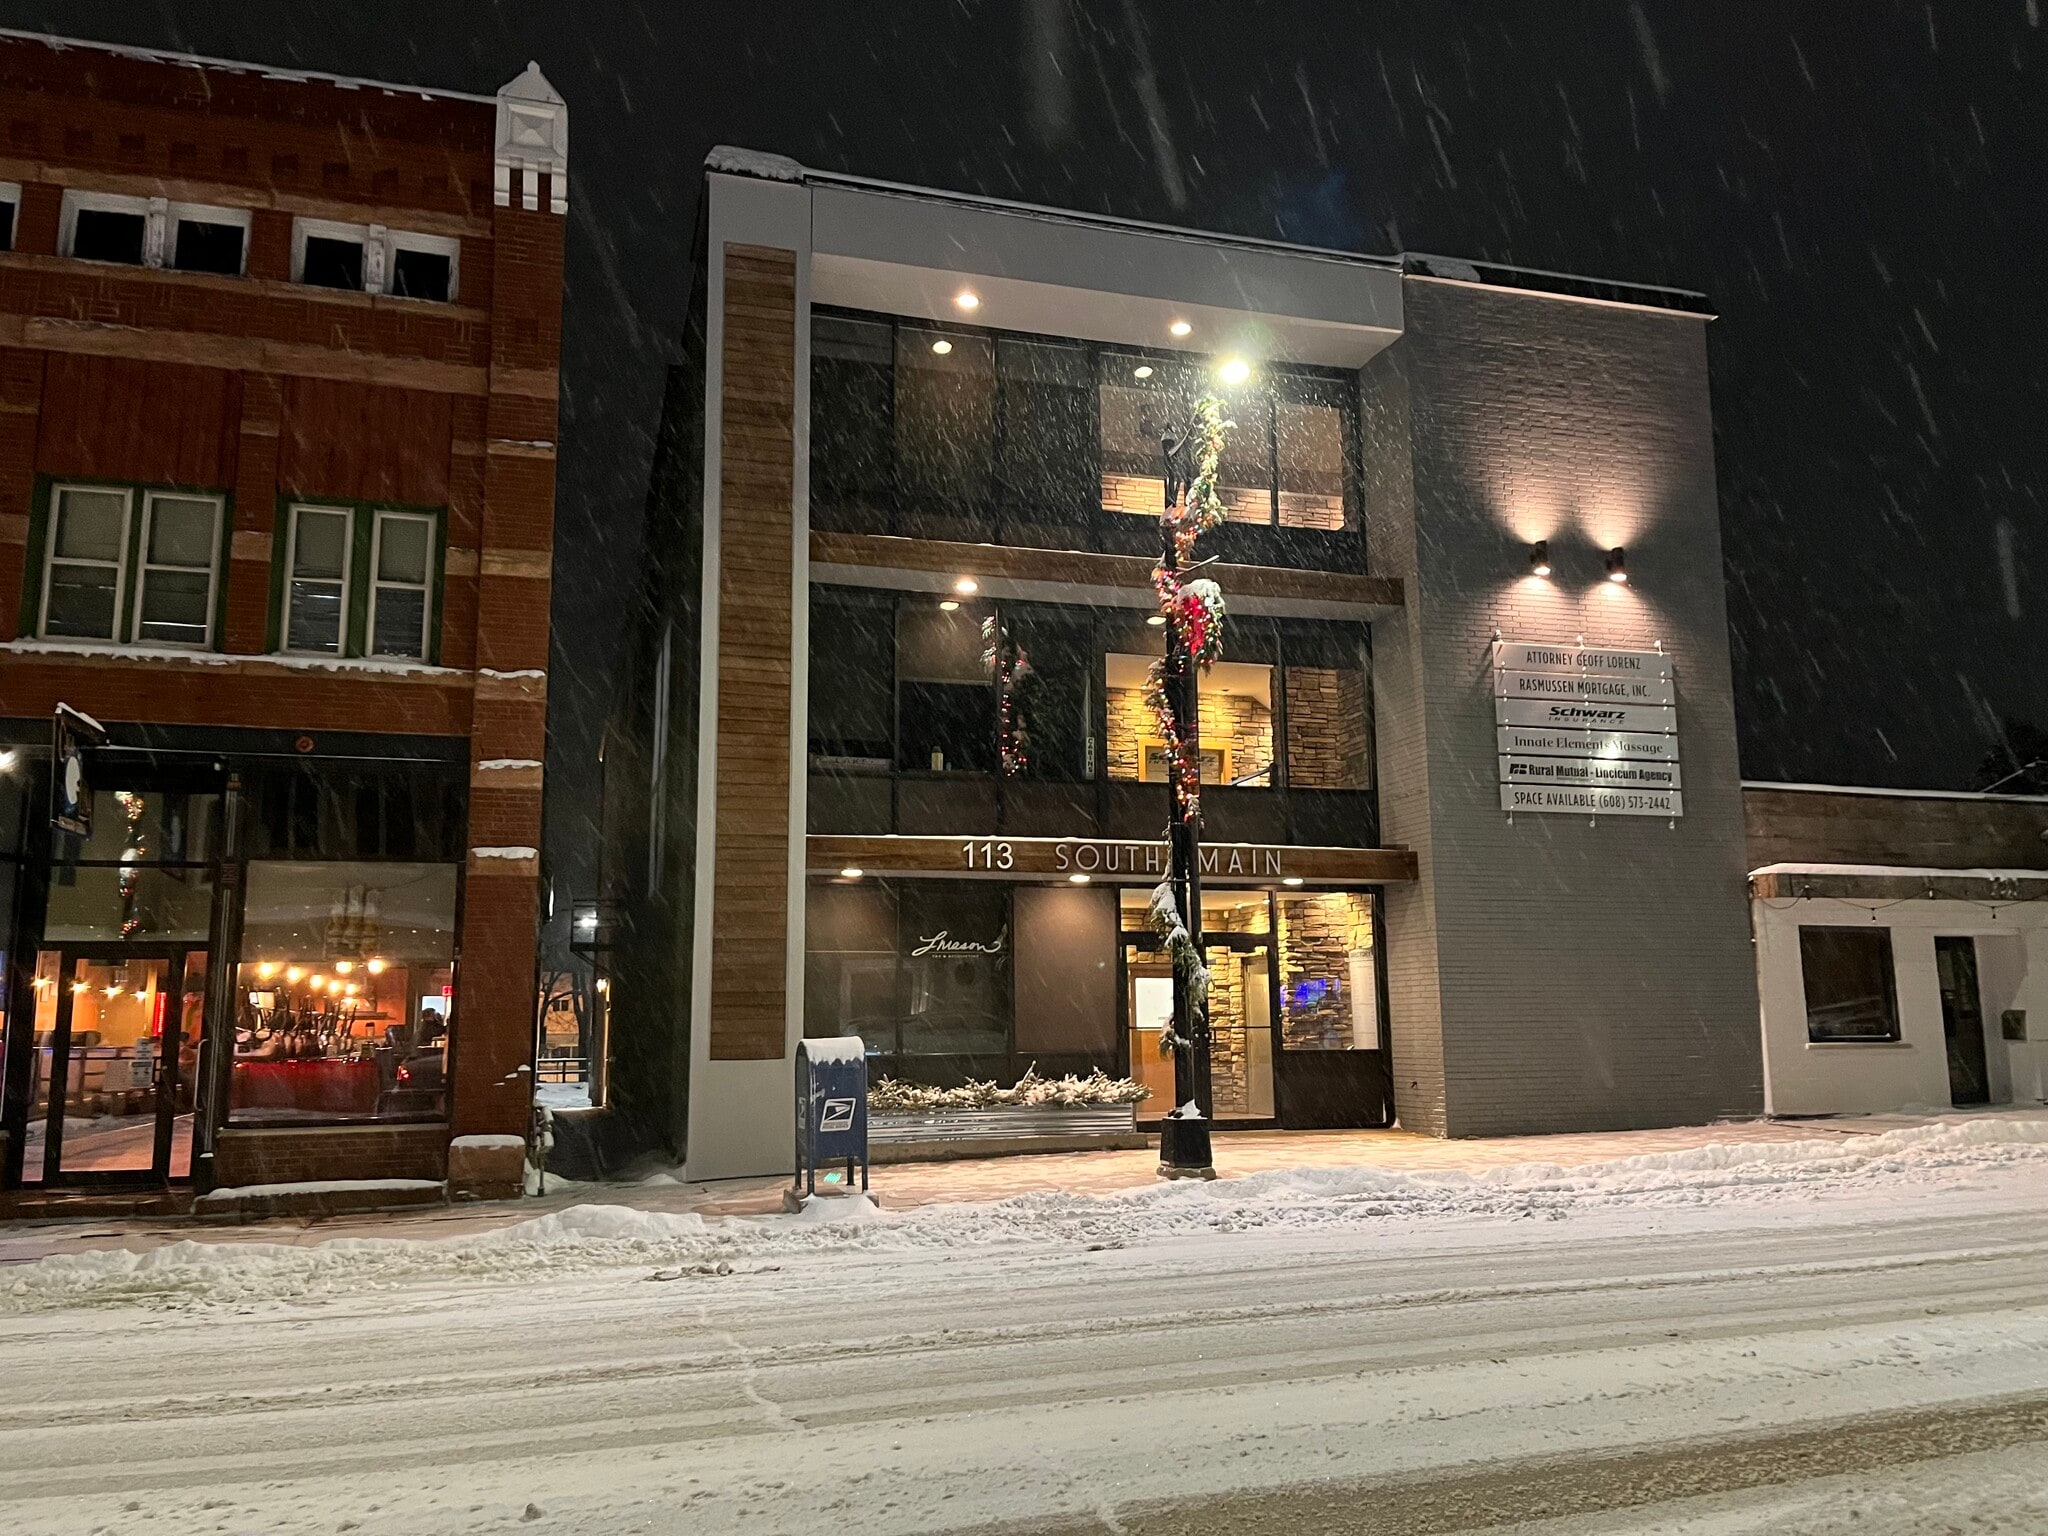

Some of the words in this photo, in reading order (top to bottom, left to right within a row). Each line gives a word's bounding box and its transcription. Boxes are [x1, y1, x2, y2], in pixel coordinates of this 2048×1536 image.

[1526, 651, 1573, 665] ATTORNEY
[1576, 654, 1604, 668] GEOFF
[1607, 656, 1641, 670] LORENZ
[1519, 678, 1575, 693] RASMUSSEN
[1577, 681, 1630, 697] MORTGAGE,
[1632, 684, 1651, 697] INC.
[1548, 706, 1626, 719] Schwarz
[1548, 716, 1625, 724] INSURANCE
[1514, 735, 1554, 748] Innate
[1529, 764, 1554, 776] Rural
[1556, 766, 1589, 777] Mutual
[1595, 767, 1638, 780] Lincicum
[1639, 769, 1673, 782] Agency
[1514, 791, 1543, 805] SPACE
[1546, 793, 1597, 807] AVAILABLE
[1599, 795, 1625, 809] (608)
[1628, 796, 1671, 809] 573-2442
[963, 841, 1014, 869] 113
[1055, 844, 1160, 872] SOUTH
[1197, 847, 1281, 875] MAIN
